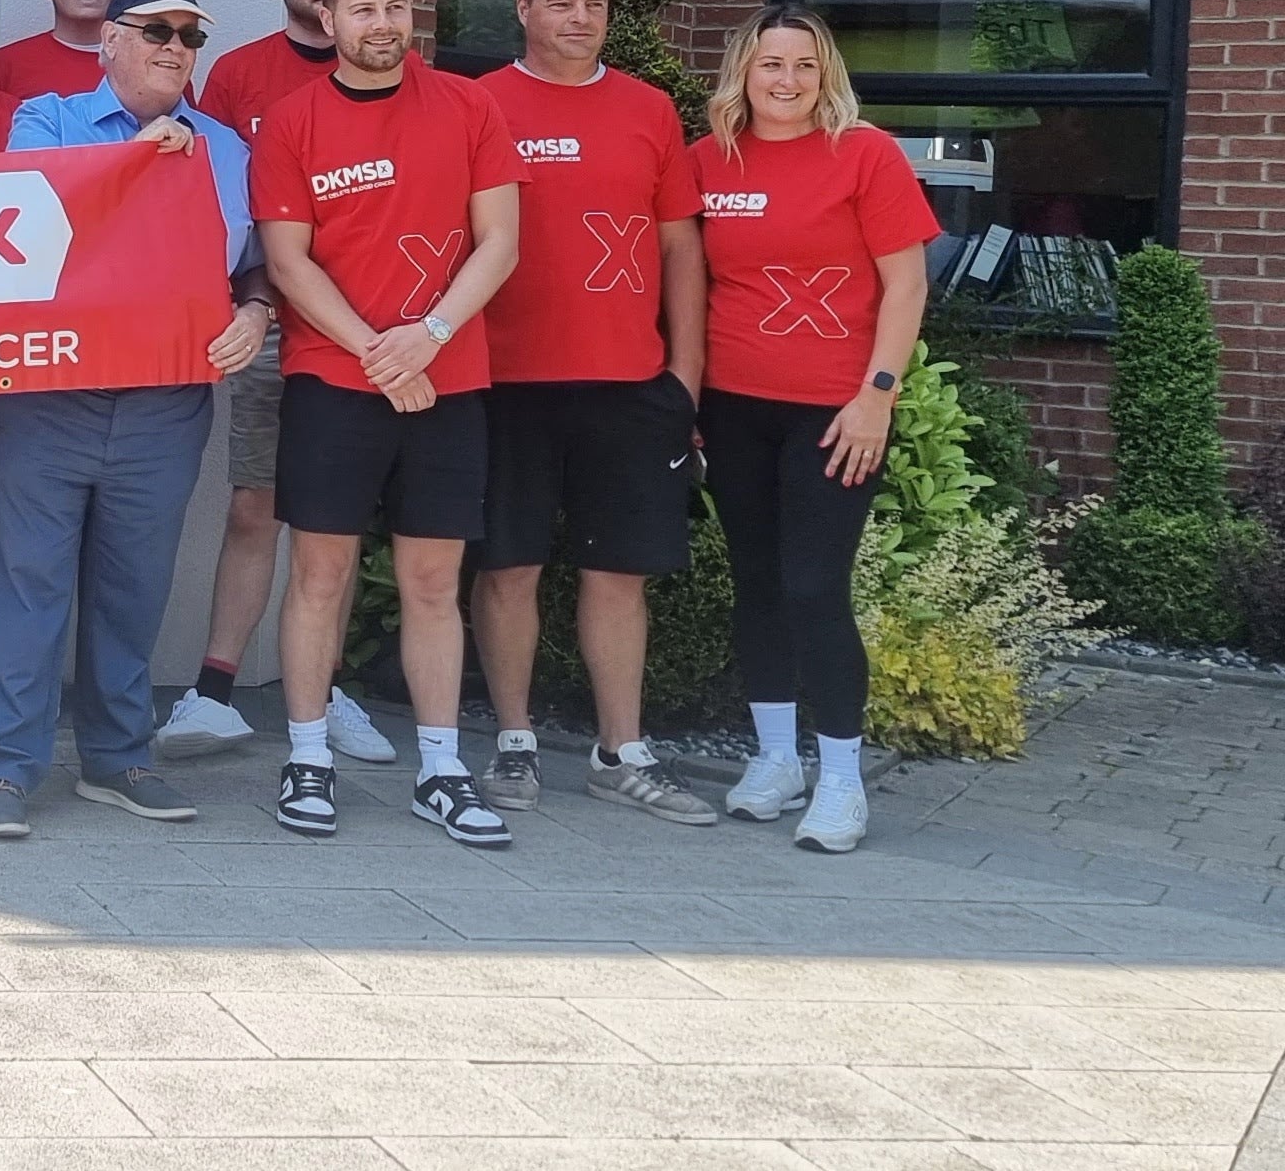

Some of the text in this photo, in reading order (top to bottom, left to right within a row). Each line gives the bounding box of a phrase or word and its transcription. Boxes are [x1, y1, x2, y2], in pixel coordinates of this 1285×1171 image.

[513, 139, 559, 156] KMS
[311, 162, 377, 195] DKMS
[701, 193, 747, 211] KMS
